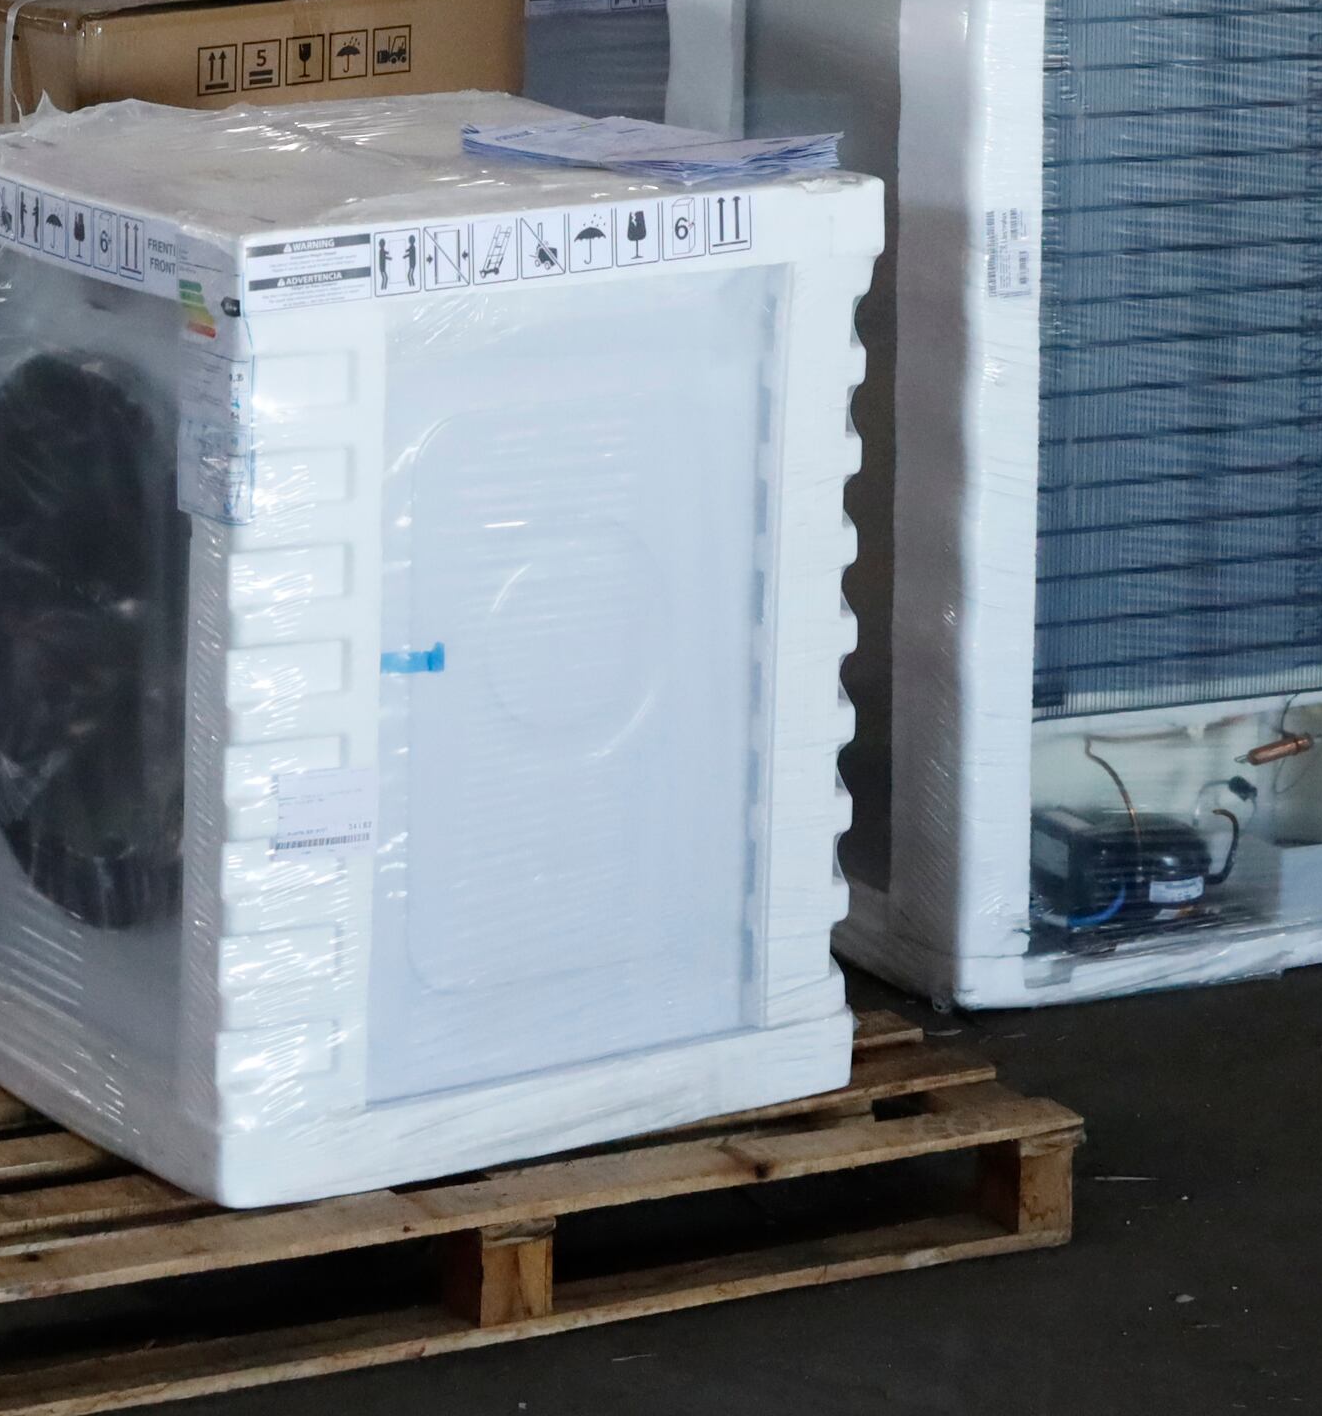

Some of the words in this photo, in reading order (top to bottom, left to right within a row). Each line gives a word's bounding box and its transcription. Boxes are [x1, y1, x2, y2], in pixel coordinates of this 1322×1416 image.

[256, 49, 267, 67] 5
[675, 217, 689, 241] 6
[292, 238, 335, 252] WARNING
[150, 257, 176, 275] FRONT
[285, 271, 342, 286] ADVERTENCIA
